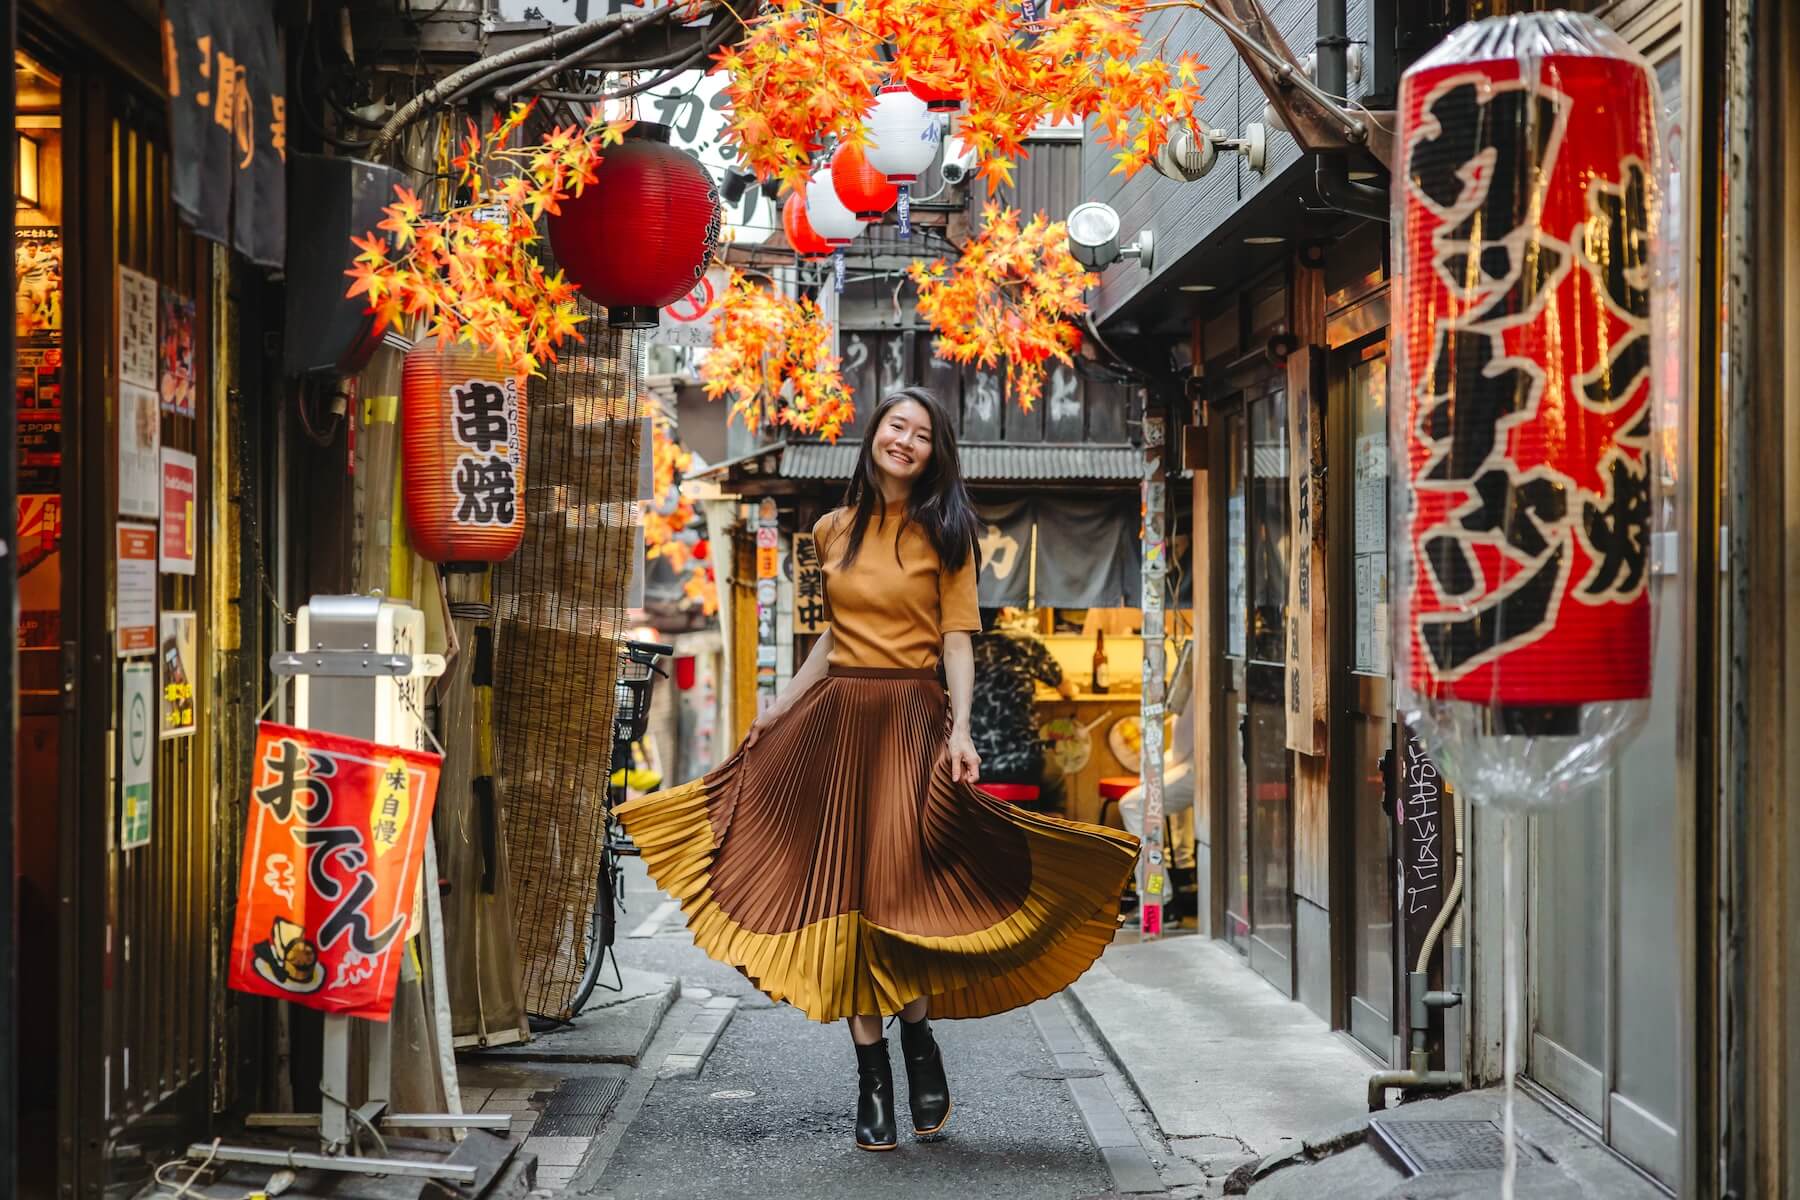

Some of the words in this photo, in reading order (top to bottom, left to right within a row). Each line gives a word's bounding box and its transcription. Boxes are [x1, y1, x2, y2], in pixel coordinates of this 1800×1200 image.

[455, 382, 515, 524] 串焼
[254, 740, 406, 956] おでん
[374, 767, 407, 846] 味自慢
